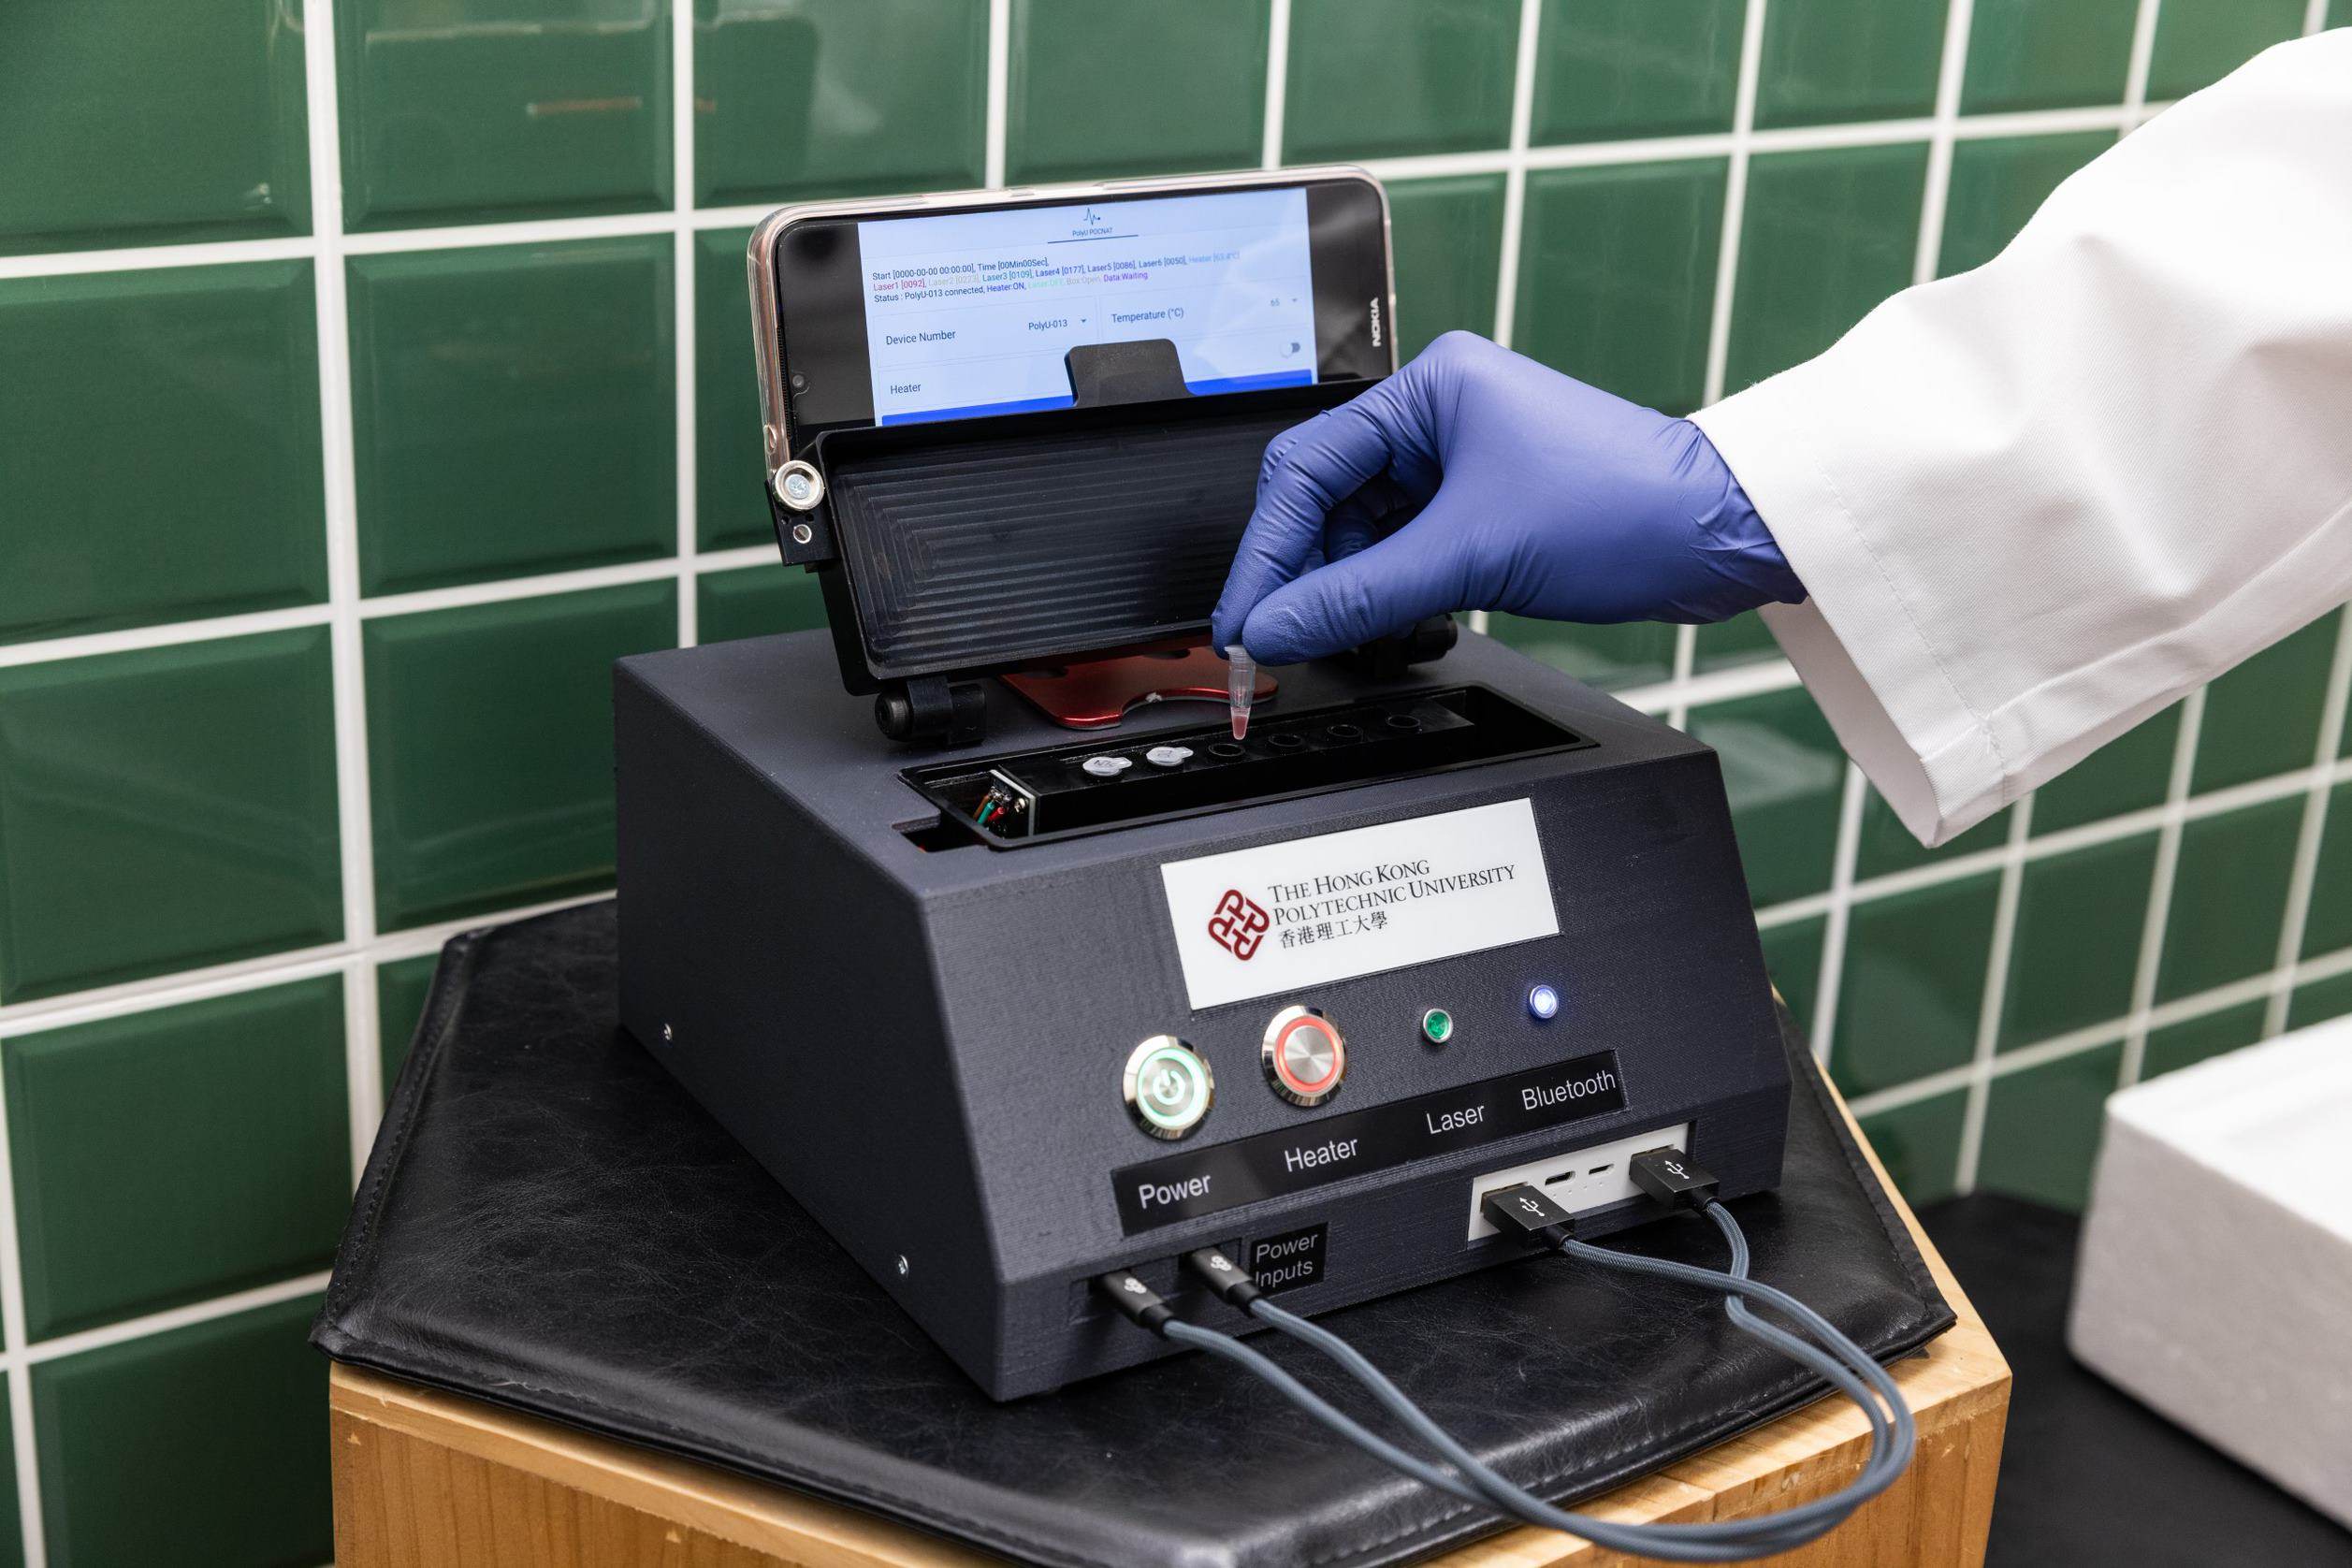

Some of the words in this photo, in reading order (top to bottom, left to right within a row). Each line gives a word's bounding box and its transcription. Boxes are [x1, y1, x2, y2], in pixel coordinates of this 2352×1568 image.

[873, 272, 891, 281] Start
[893, 268, 937, 280] [0000-00-00
[978, 263, 996, 271] Time
[873, 283, 898, 291] Laser1
[901, 279, 926, 290] [0092],
[982, 271, 1007, 282] Laser3
[1009, 269, 1034, 281] [0109],
[1036, 268, 1060, 277] Laser4
[1061, 265, 1085, 276] [0177],
[1087, 264, 1111, 272] Laser5
[1139, 258, 1162, 268] Laser6
[874, 294, 898, 303] Status
[905, 289, 942, 301] PolyU-013
[945, 286, 984, 297] connected,
[987, 283, 1010, 293] Heater
[1104, 273, 1120, 282] Data
[1123, 271, 1148, 281] Waiting
[1028, 319, 1067, 331] PolyU-013
[1111, 310, 1166, 324] Temperature
[1168, 307, 1184, 319] (°C)
[1370, 297, 1382, 347] NOKIA
[886, 334, 917, 345] Device
[920, 330, 956, 342] Number
[891, 383, 922, 395] Heater
[1269, 882, 1312, 903] THE
[1314, 870, 1373, 895] HONG
[1375, 859, 1430, 883] KONG
[1273, 886, 1407, 926] POLYTECHNIC
[1409, 864, 1516, 899] UNIVERSITY
[1279, 910, 1388, 950] 香港理工大學
[1521, 1069, 1617, 1111] Bluetooth
[1426, 1102, 1486, 1135] Laser
[1285, 1139, 1358, 1173] Heater
[1139, 1175, 1211, 1210] Power
[1256, 1234, 1318, 1264] Power
[1256, 1259, 1314, 1288] Inputs
